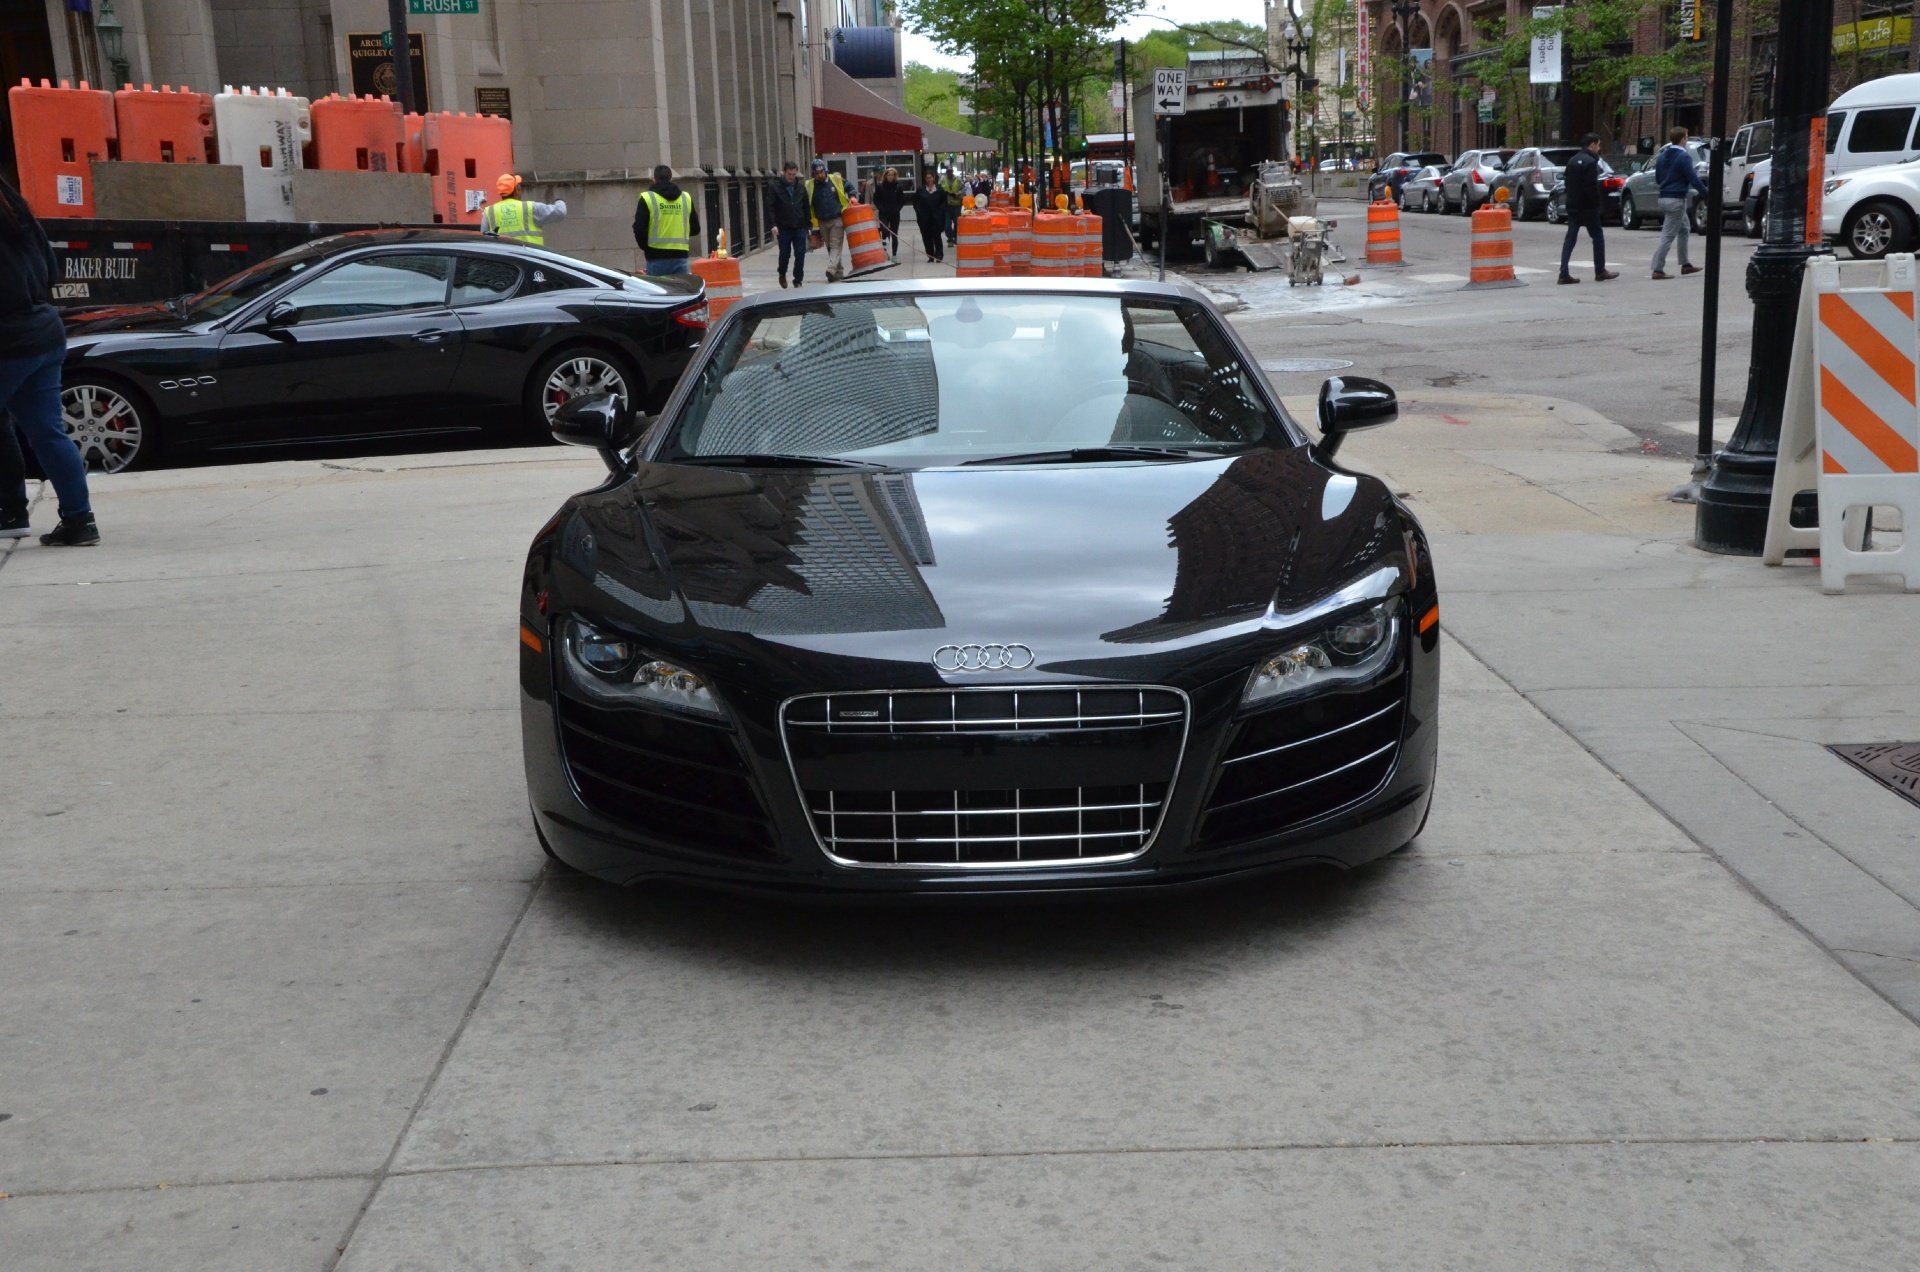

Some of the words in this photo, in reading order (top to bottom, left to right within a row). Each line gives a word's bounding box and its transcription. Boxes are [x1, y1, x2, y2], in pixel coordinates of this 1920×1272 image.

[423, 0, 461, 12] RUSH
[465, 1, 474, 9] ST
[1680, 0, 1694, 38] EINST
[352, 49, 387, 57] QUIGLEY
[1158, 72, 1183, 83] ONE
[1157, 85, 1183, 96] WAY
[65, 257, 102, 279] BAKER
[105, 257, 138, 279] BUILT
